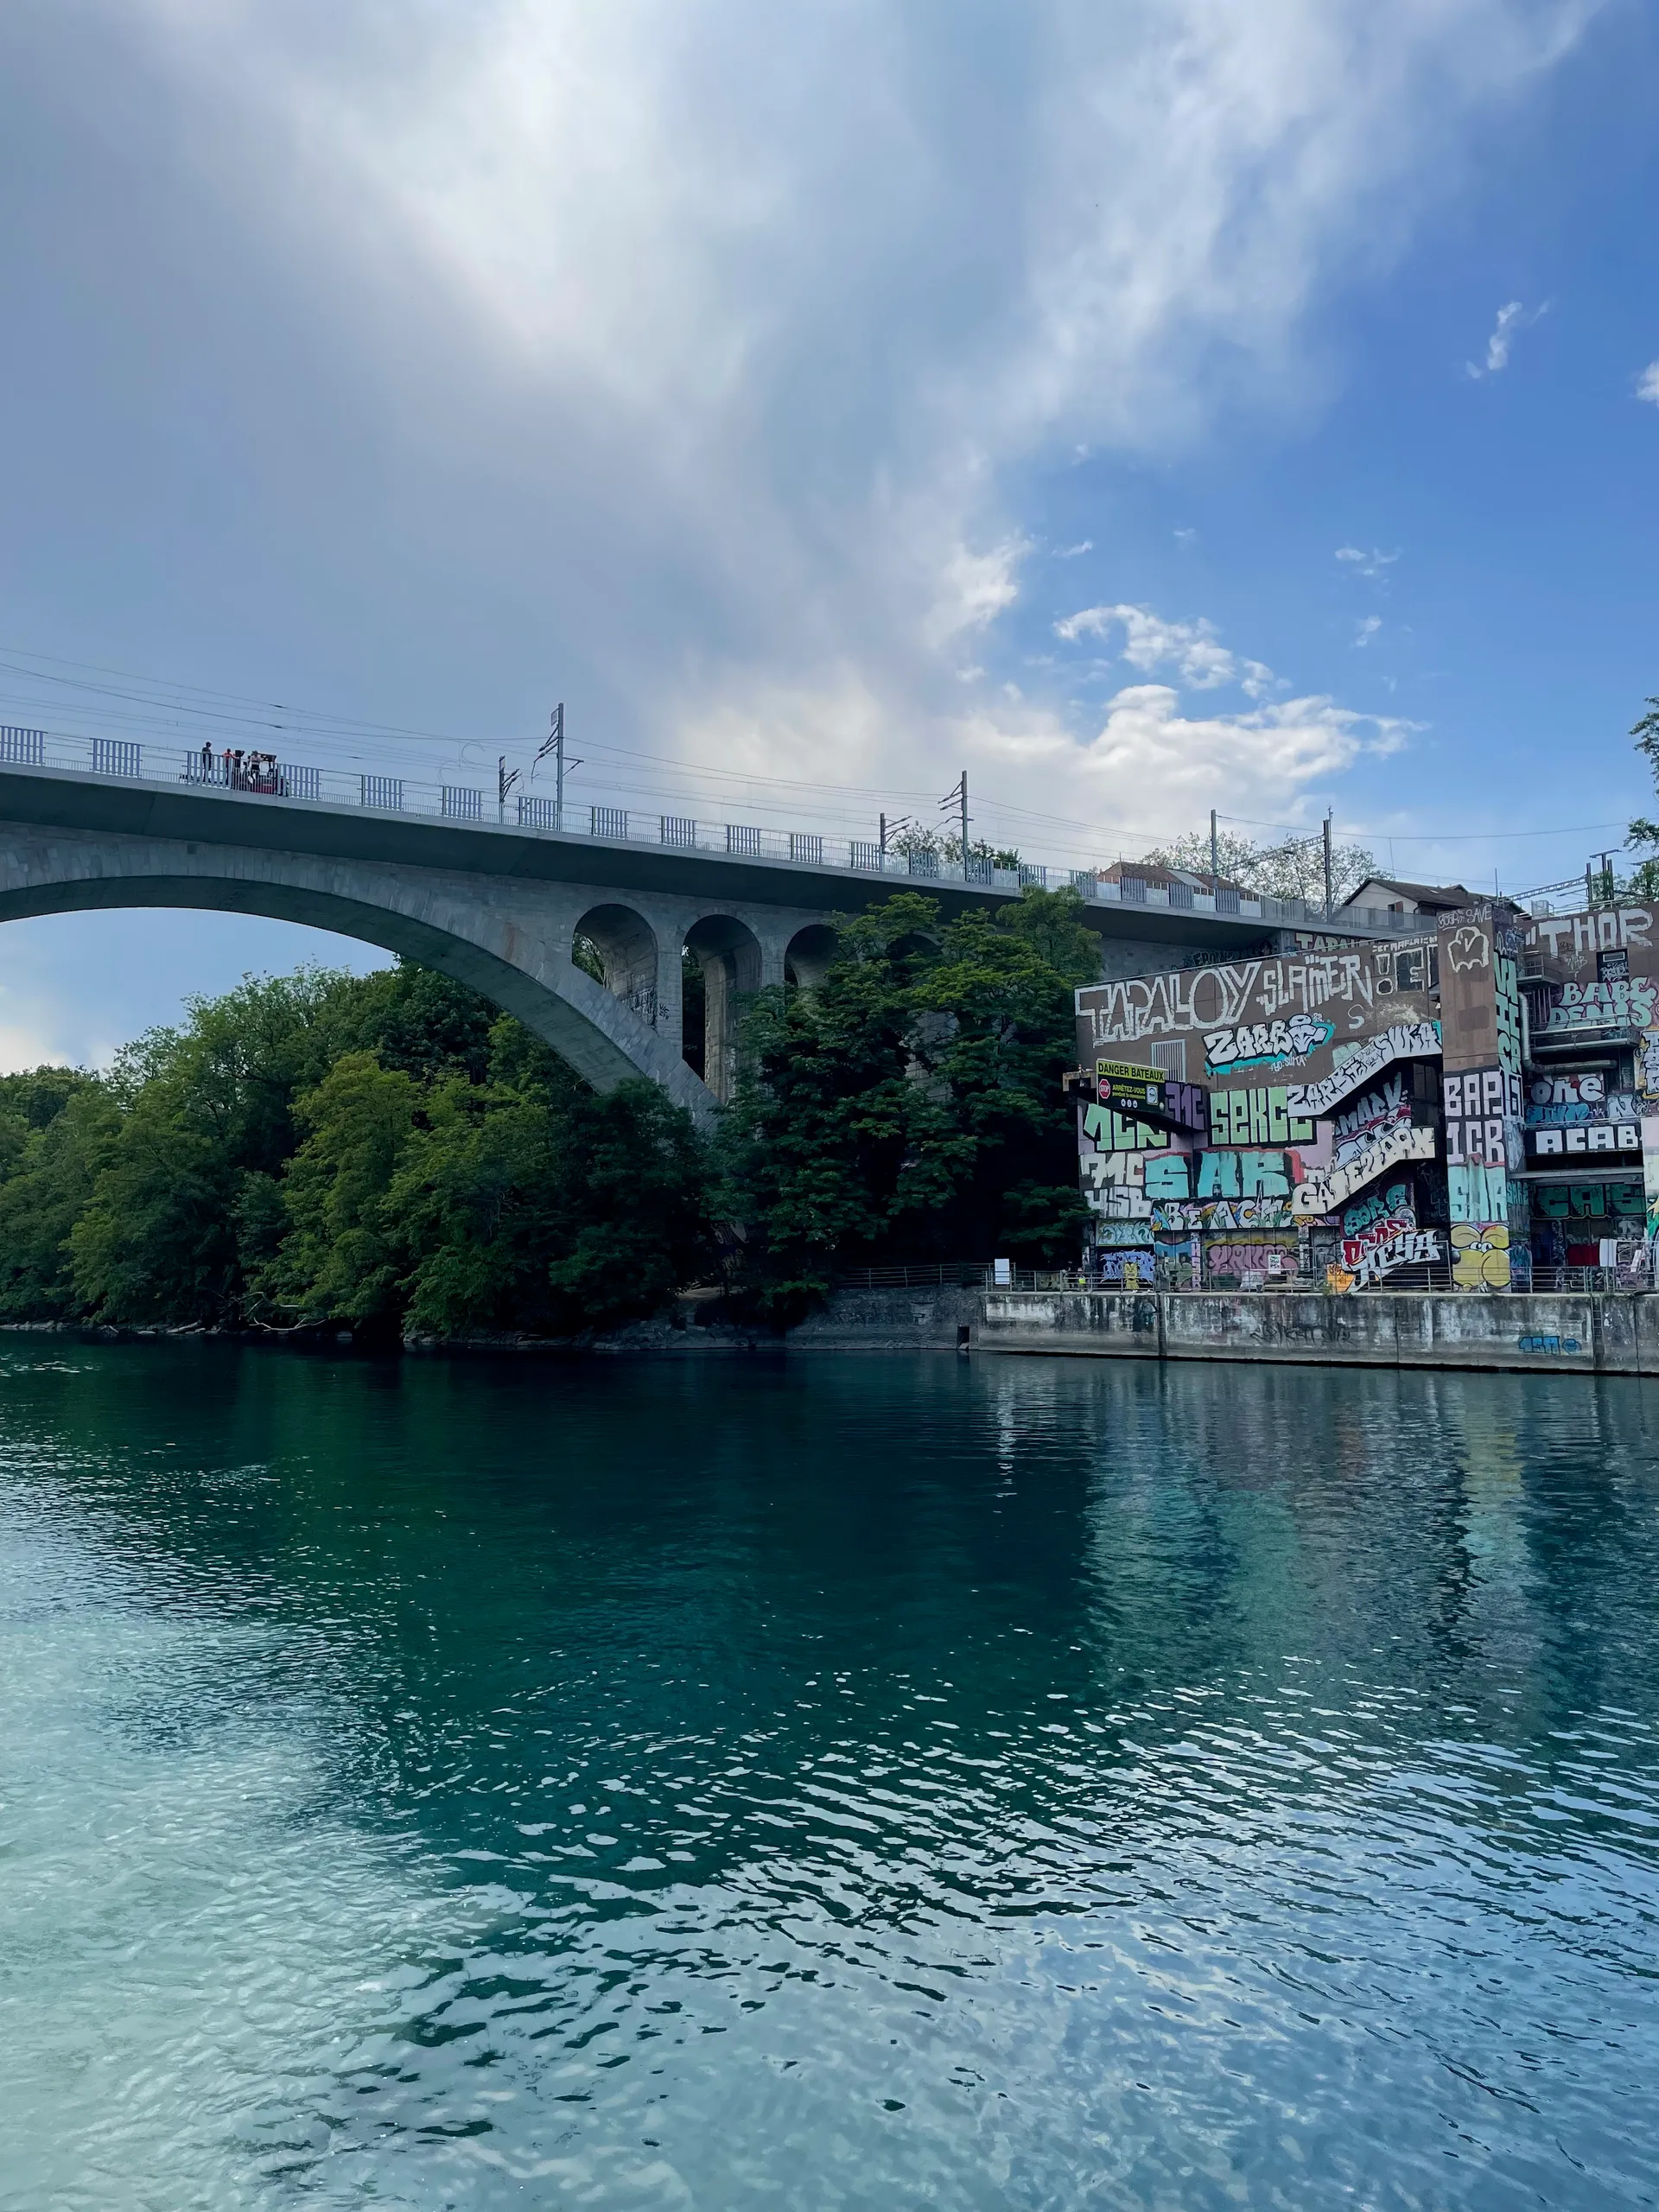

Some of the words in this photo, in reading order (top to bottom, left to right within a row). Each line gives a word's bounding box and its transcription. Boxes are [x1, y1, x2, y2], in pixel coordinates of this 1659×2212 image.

[1098, 1063, 1129, 1077] DANGER
[1131, 1067, 1165, 1081] BATEAUX
[1535, 1126, 1639, 1154] ACAB
